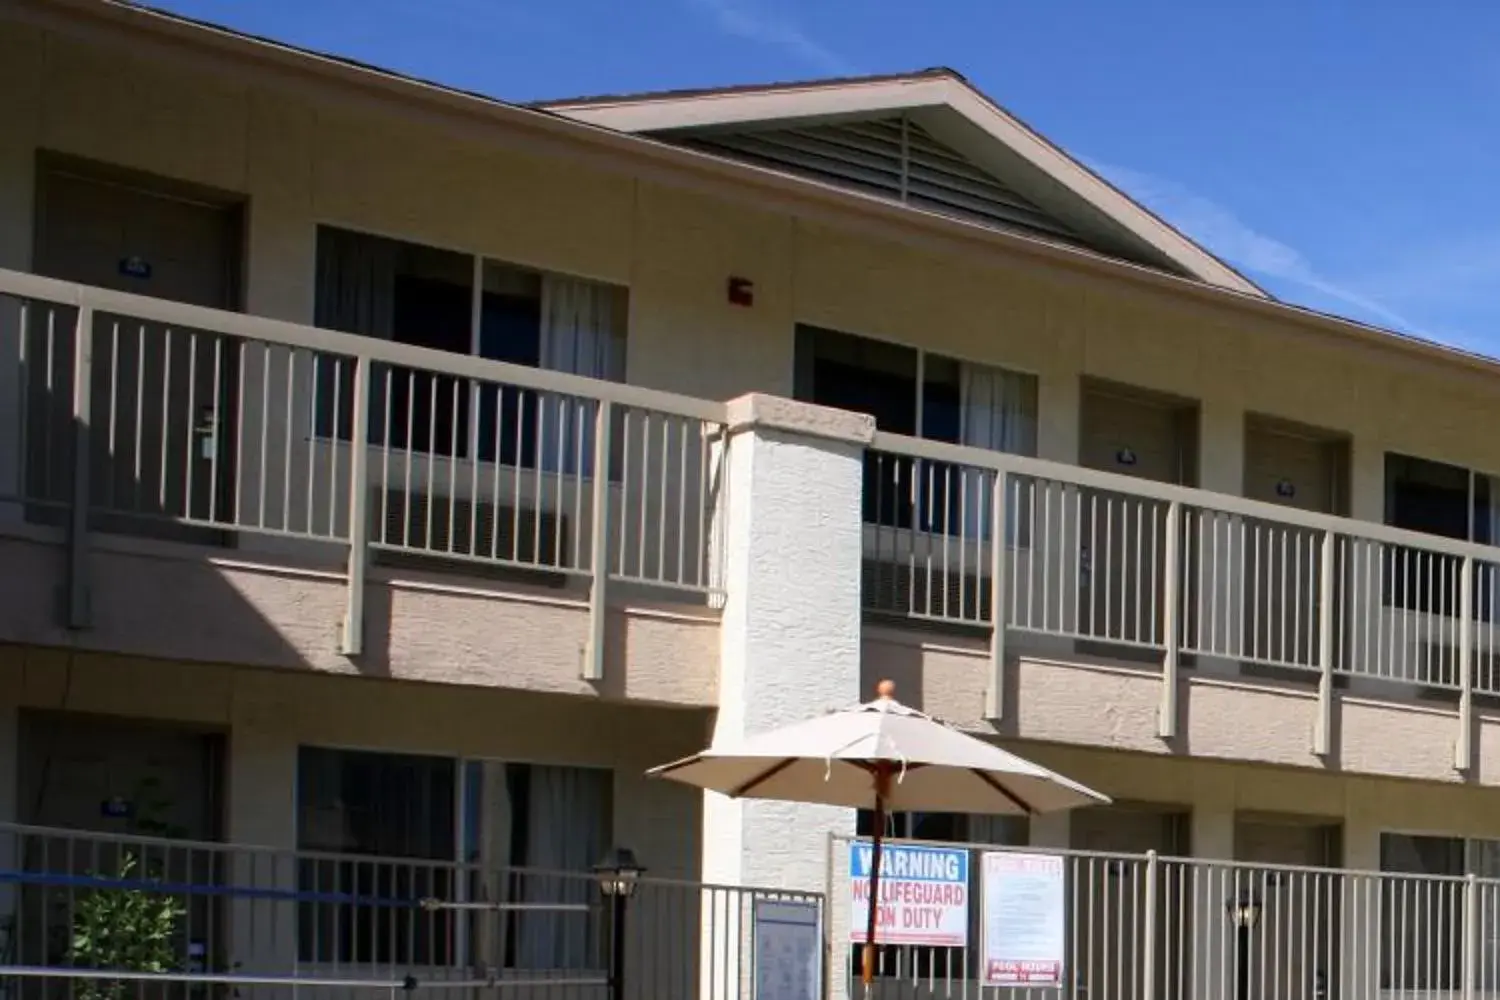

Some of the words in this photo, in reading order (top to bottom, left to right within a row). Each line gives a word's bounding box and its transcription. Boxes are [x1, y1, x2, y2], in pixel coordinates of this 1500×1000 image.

[859, 847, 959, 880] WARNING
[853, 879, 871, 901] NO
[882, 880, 964, 906] LIFEGUARD
[876, 906, 896, 928] ON
[903, 907, 943, 929] DUTY
